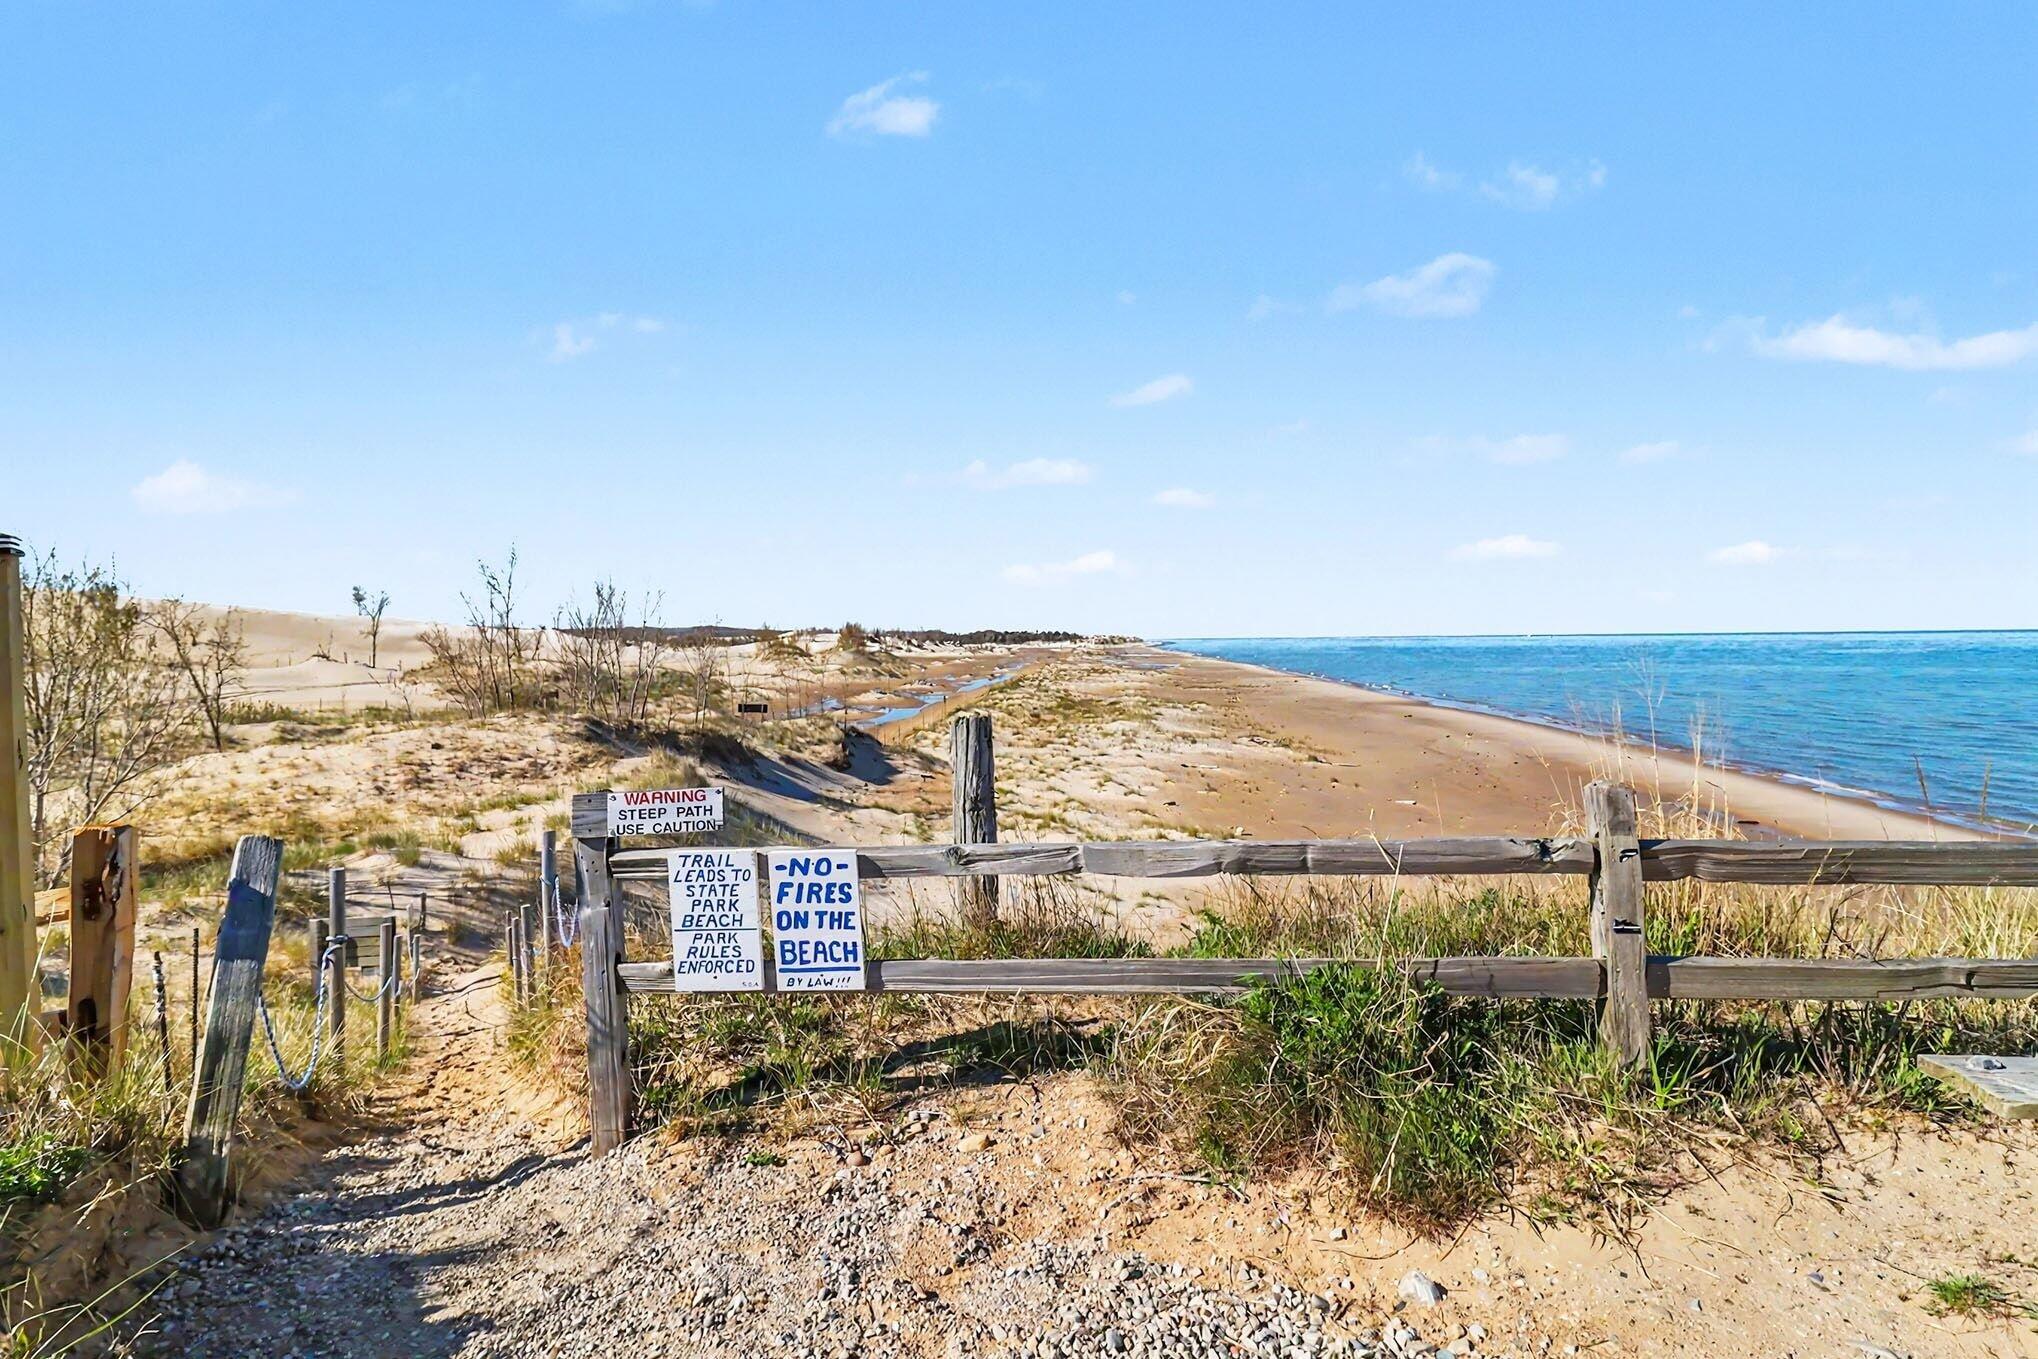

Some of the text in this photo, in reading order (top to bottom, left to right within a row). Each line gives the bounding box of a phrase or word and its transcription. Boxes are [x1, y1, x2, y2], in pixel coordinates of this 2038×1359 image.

[624, 789, 706, 805] WARNING
[619, 805, 713, 820] STEEP PATH
[616, 823, 644, 835] USE
[679, 855, 734, 867] TRAIL
[674, 869, 751, 882] LEADS TO
[686, 884, 739, 897] STATE
[777, 882, 852, 904] FIRES
[692, 899, 739, 912] PARK
[682, 914, 743, 928] BEACH
[777, 911, 855, 930] ON THE
[693, 933, 738, 944] PARK
[687, 946, 741, 958] RULES
[779, 940, 858, 965] BEACH
[678, 960, 755, 974] ENFORCED
[787, 977, 802, 986] BY
